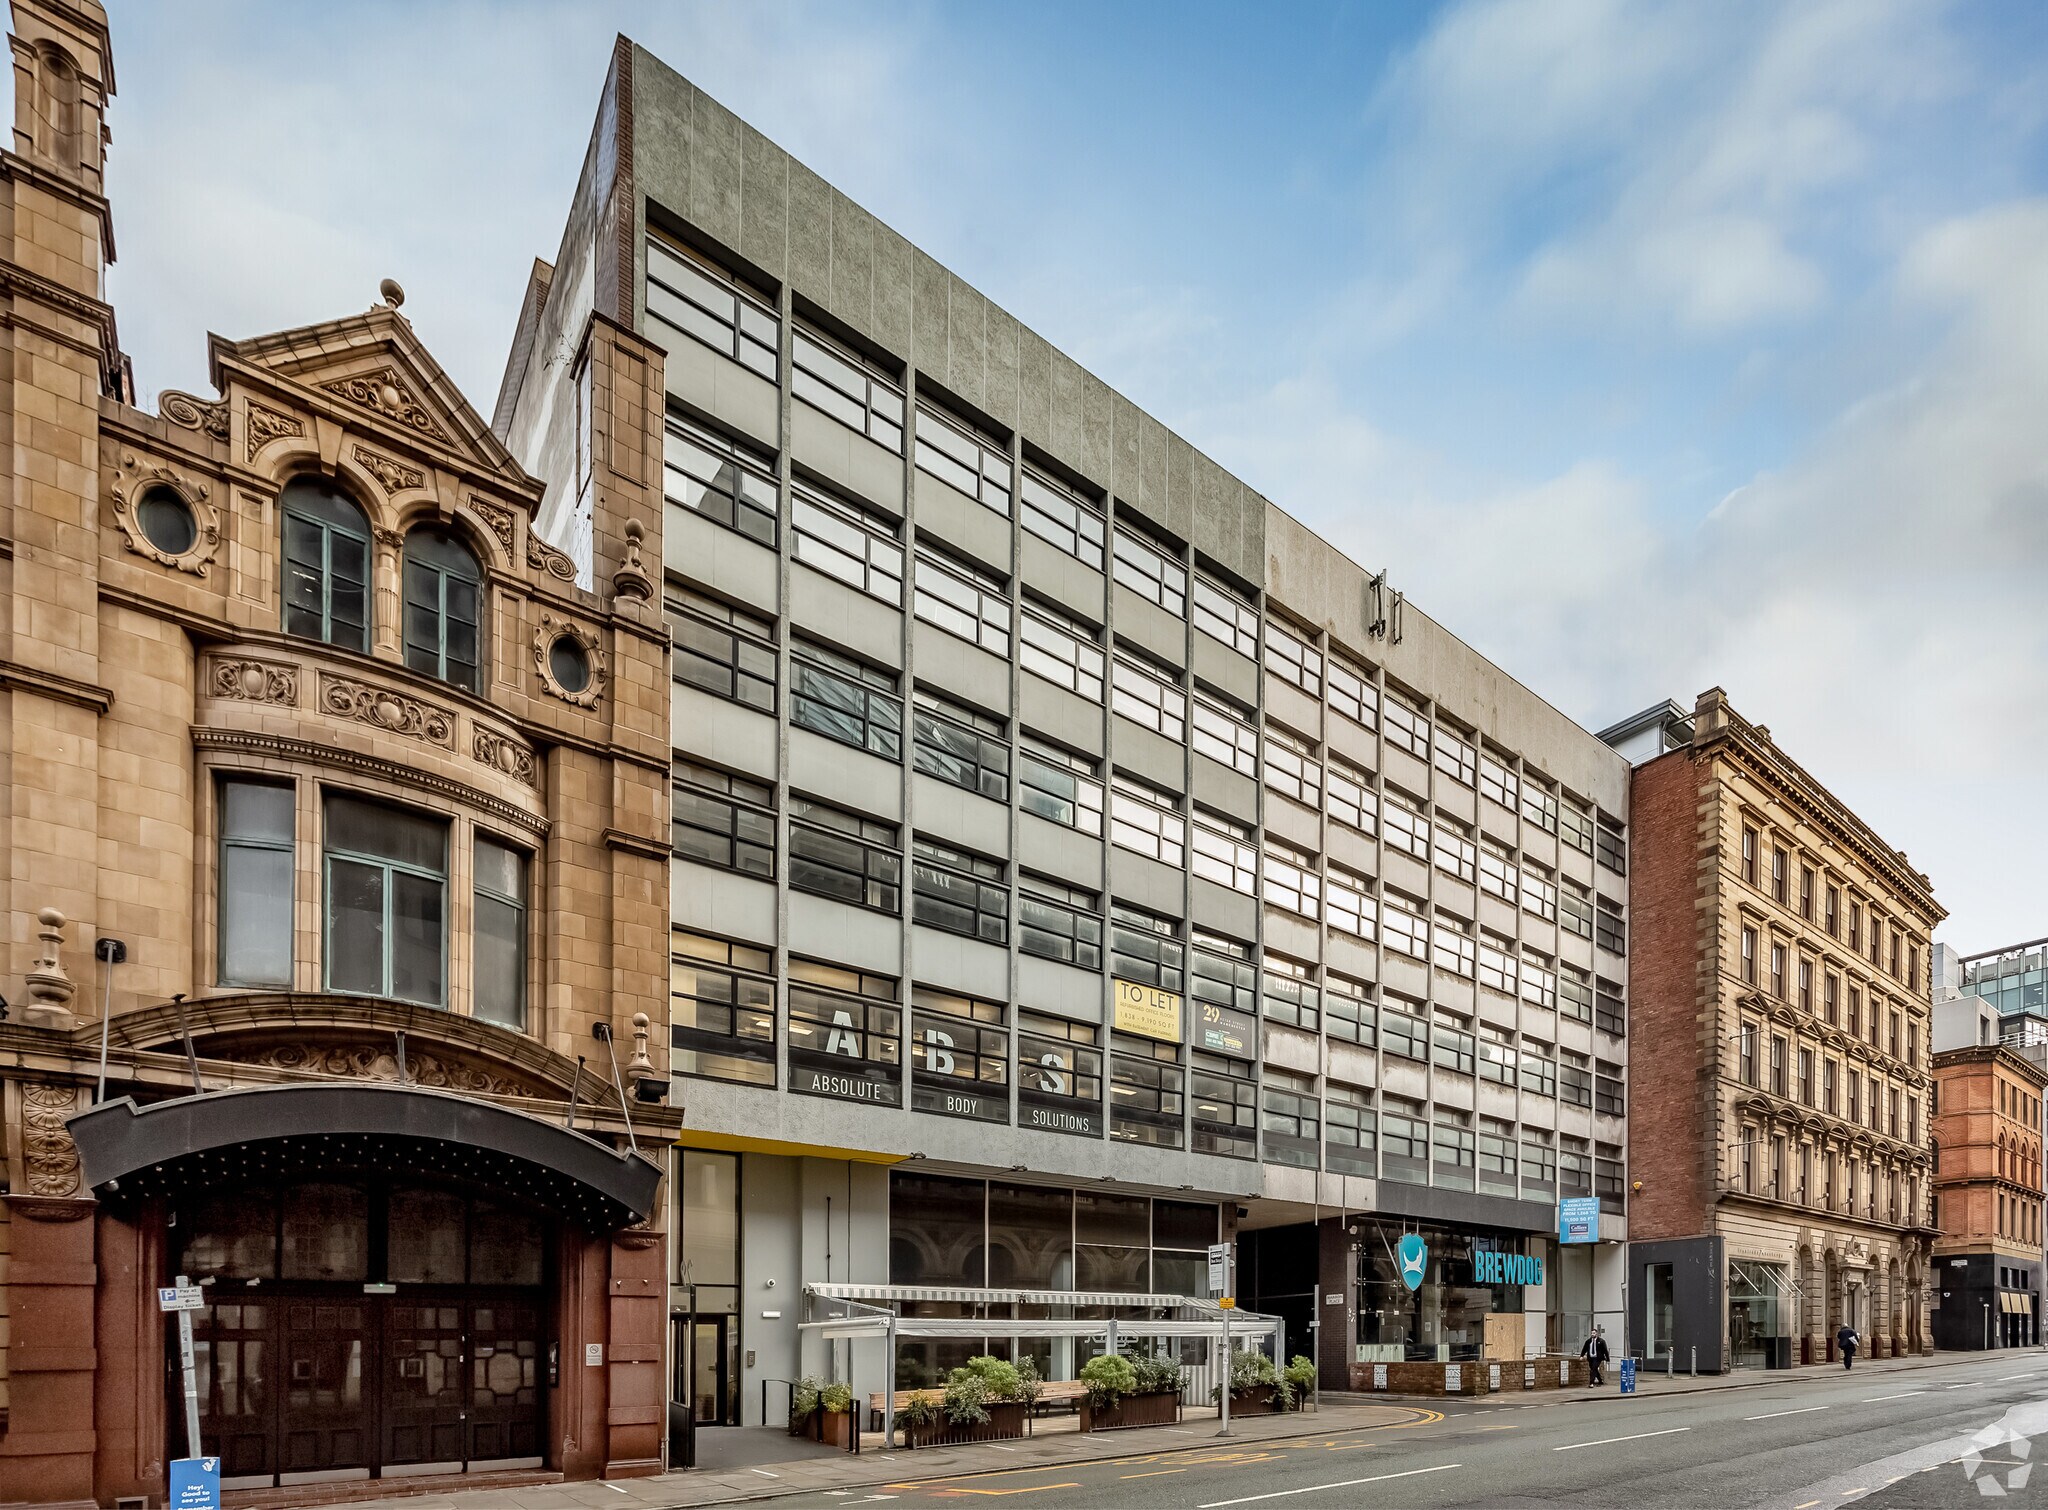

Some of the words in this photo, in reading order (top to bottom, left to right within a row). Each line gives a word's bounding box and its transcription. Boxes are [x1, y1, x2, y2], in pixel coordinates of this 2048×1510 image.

[1120, 1001, 1144, 1012] REFURBISHED
[1145, 1008, 1159, 1016] OFFICE
[1159, 1011, 1175, 1020] FLOORS
[1121, 983, 1142, 1002] TO
[1150, 991, 1174, 1011] LET
[1158, 1020, 1167, 1028] SQ
[1203, 1004, 1220, 1023] 29
[826, 1010, 859, 1058] A
[926, 1029, 955, 1075] B
[1041, 1054, 1066, 1094] S
[812, 1074, 881, 1100] ABSOLUTE
[947, 1096, 977, 1115] BODY
[1033, 1109, 1089, 1132] SOLUTIONS
[1475, 1250, 1543, 1286] BREWDOG
